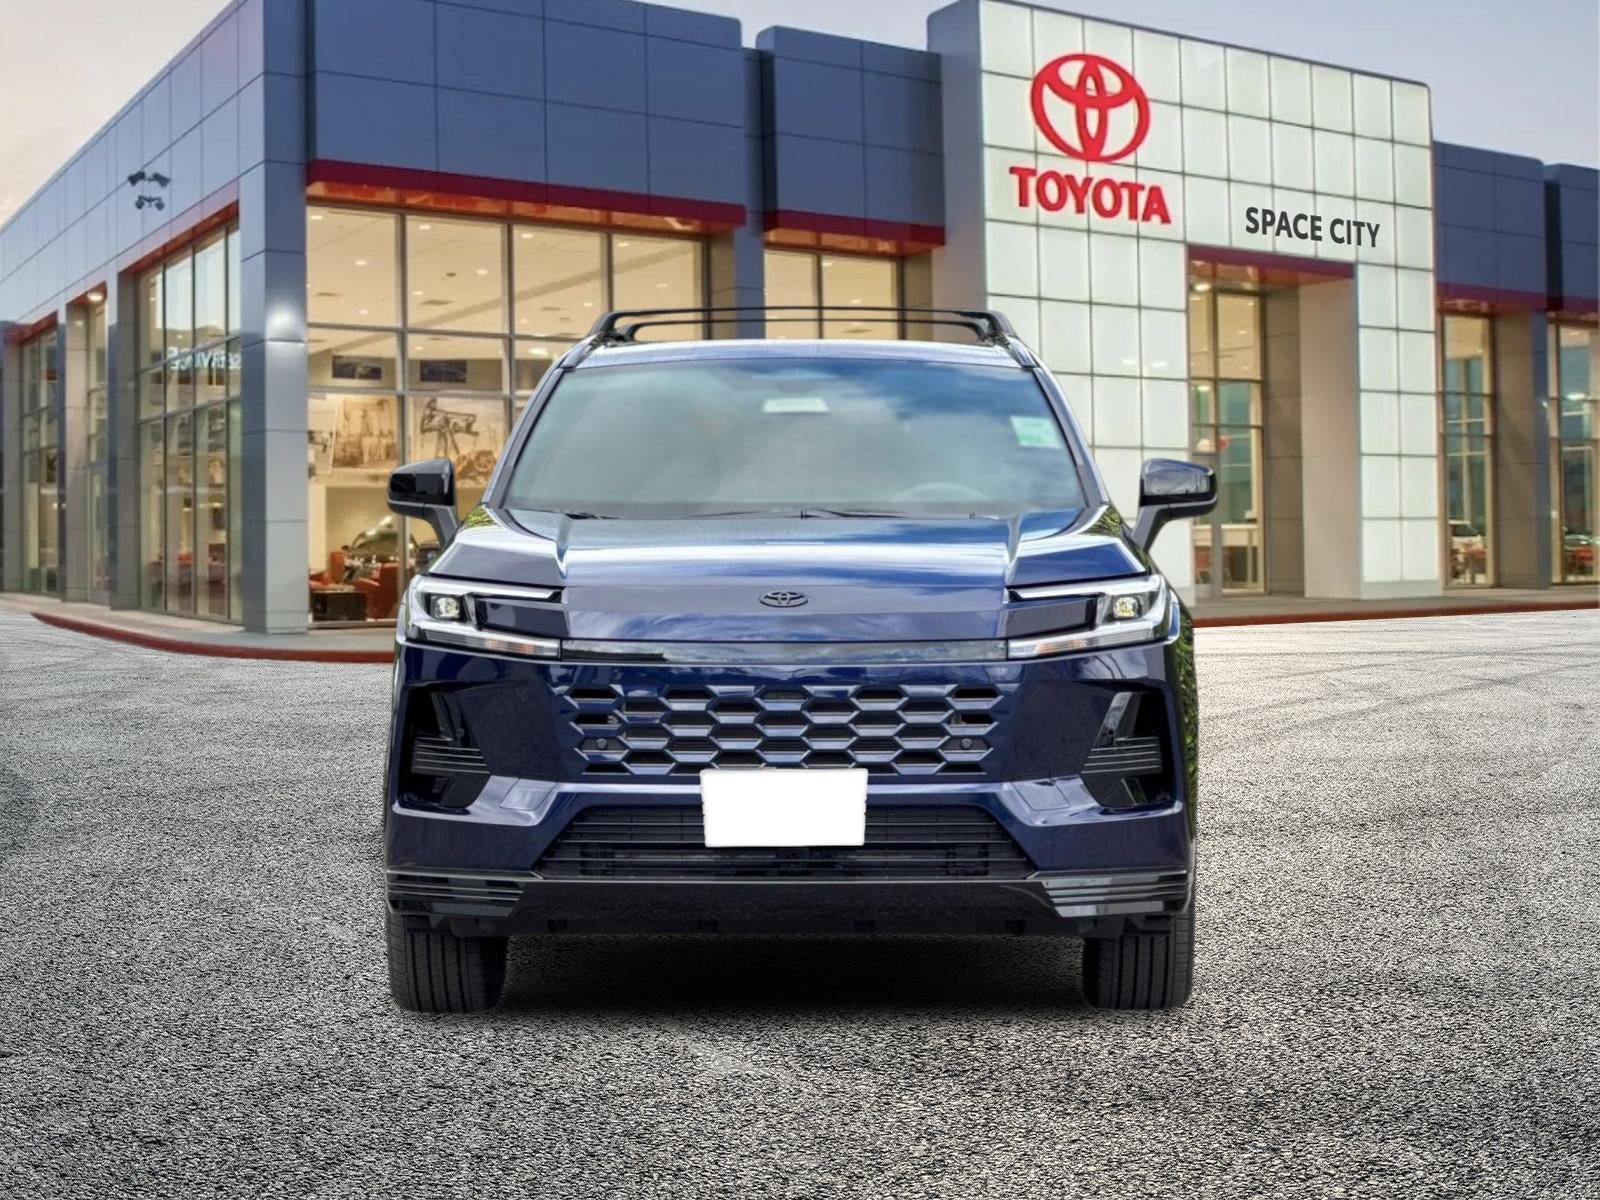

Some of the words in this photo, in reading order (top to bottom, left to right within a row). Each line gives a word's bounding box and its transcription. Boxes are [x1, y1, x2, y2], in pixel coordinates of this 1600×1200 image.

[1009, 166, 1171, 224] TOYOTA
[1245, 206, 1322, 241] SPACE
[1329, 218, 1380, 247] CITY
